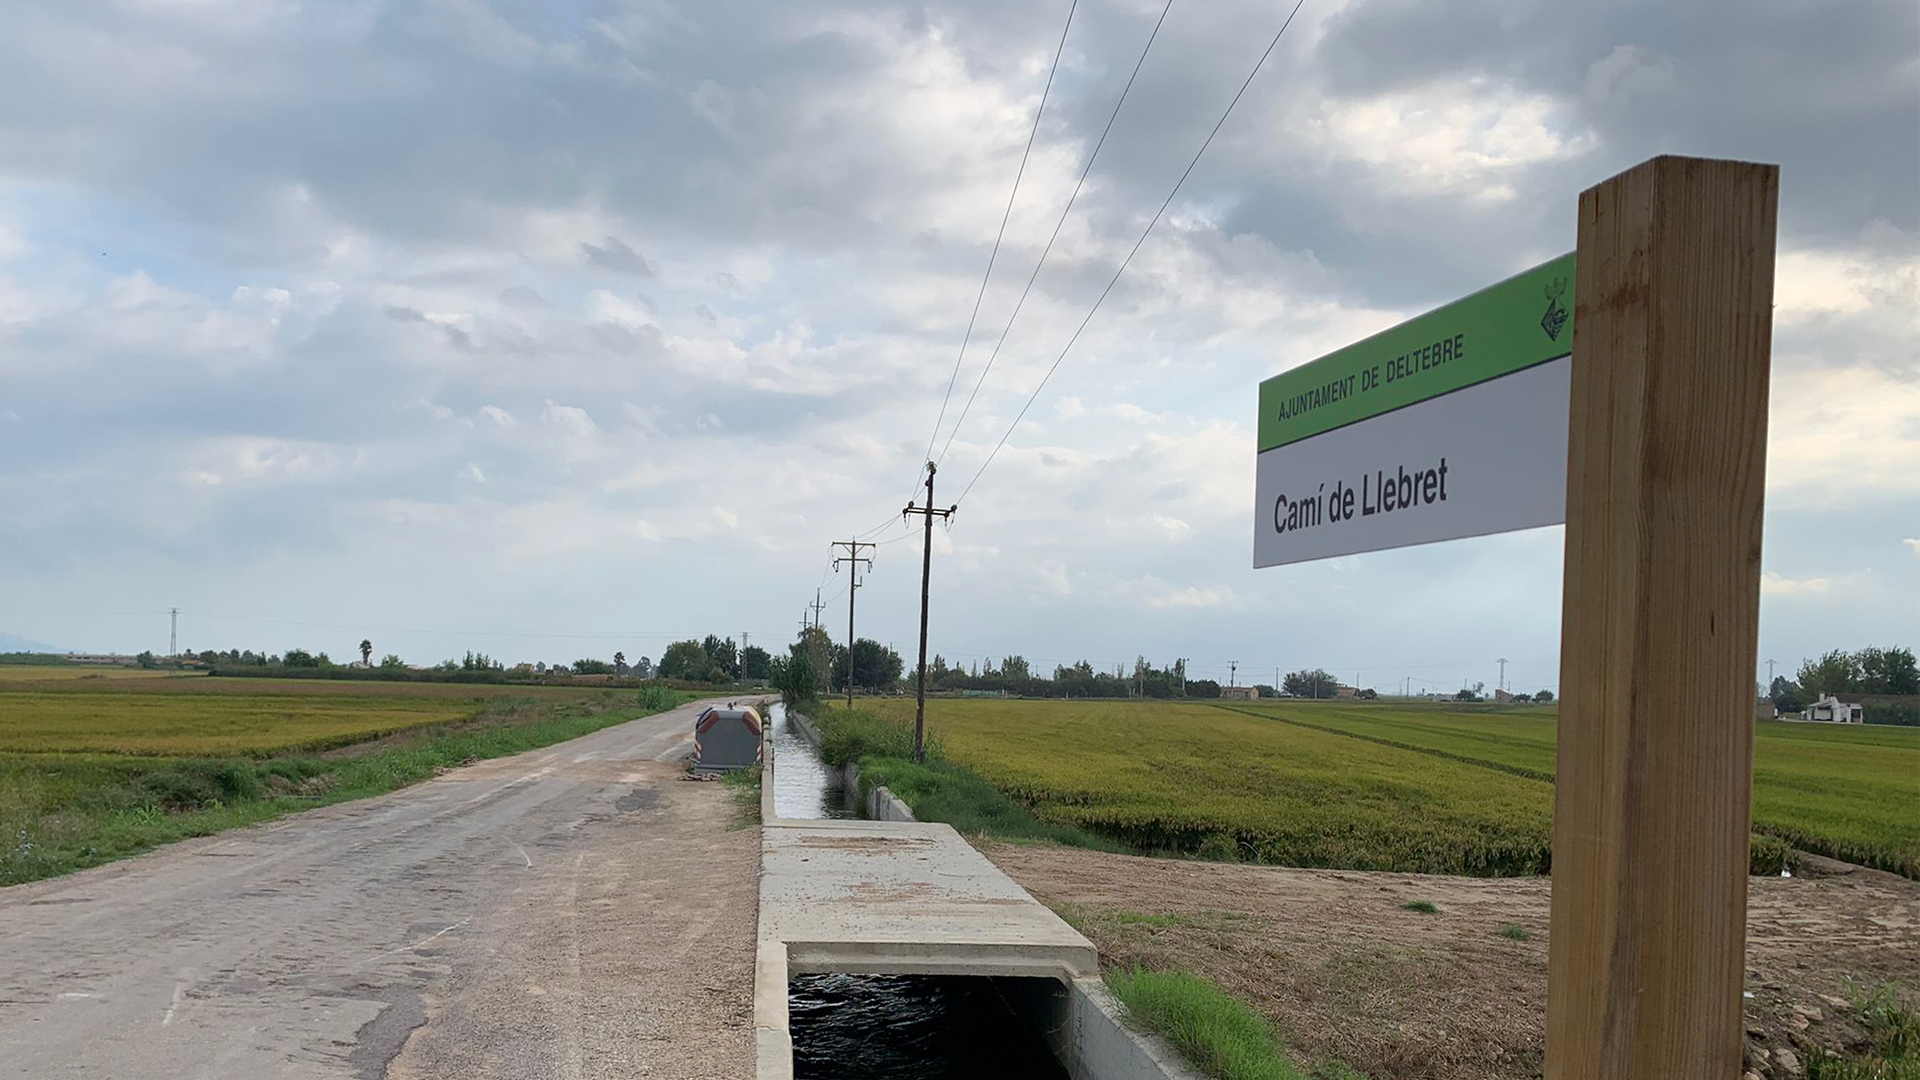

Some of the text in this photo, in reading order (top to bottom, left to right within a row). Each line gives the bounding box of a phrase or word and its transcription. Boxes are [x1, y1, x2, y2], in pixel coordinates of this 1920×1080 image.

[1278, 333, 1464, 421] AJUNTAMENT DE DELTEBRE
[1274, 457, 1448, 534] Camí de Llebret
